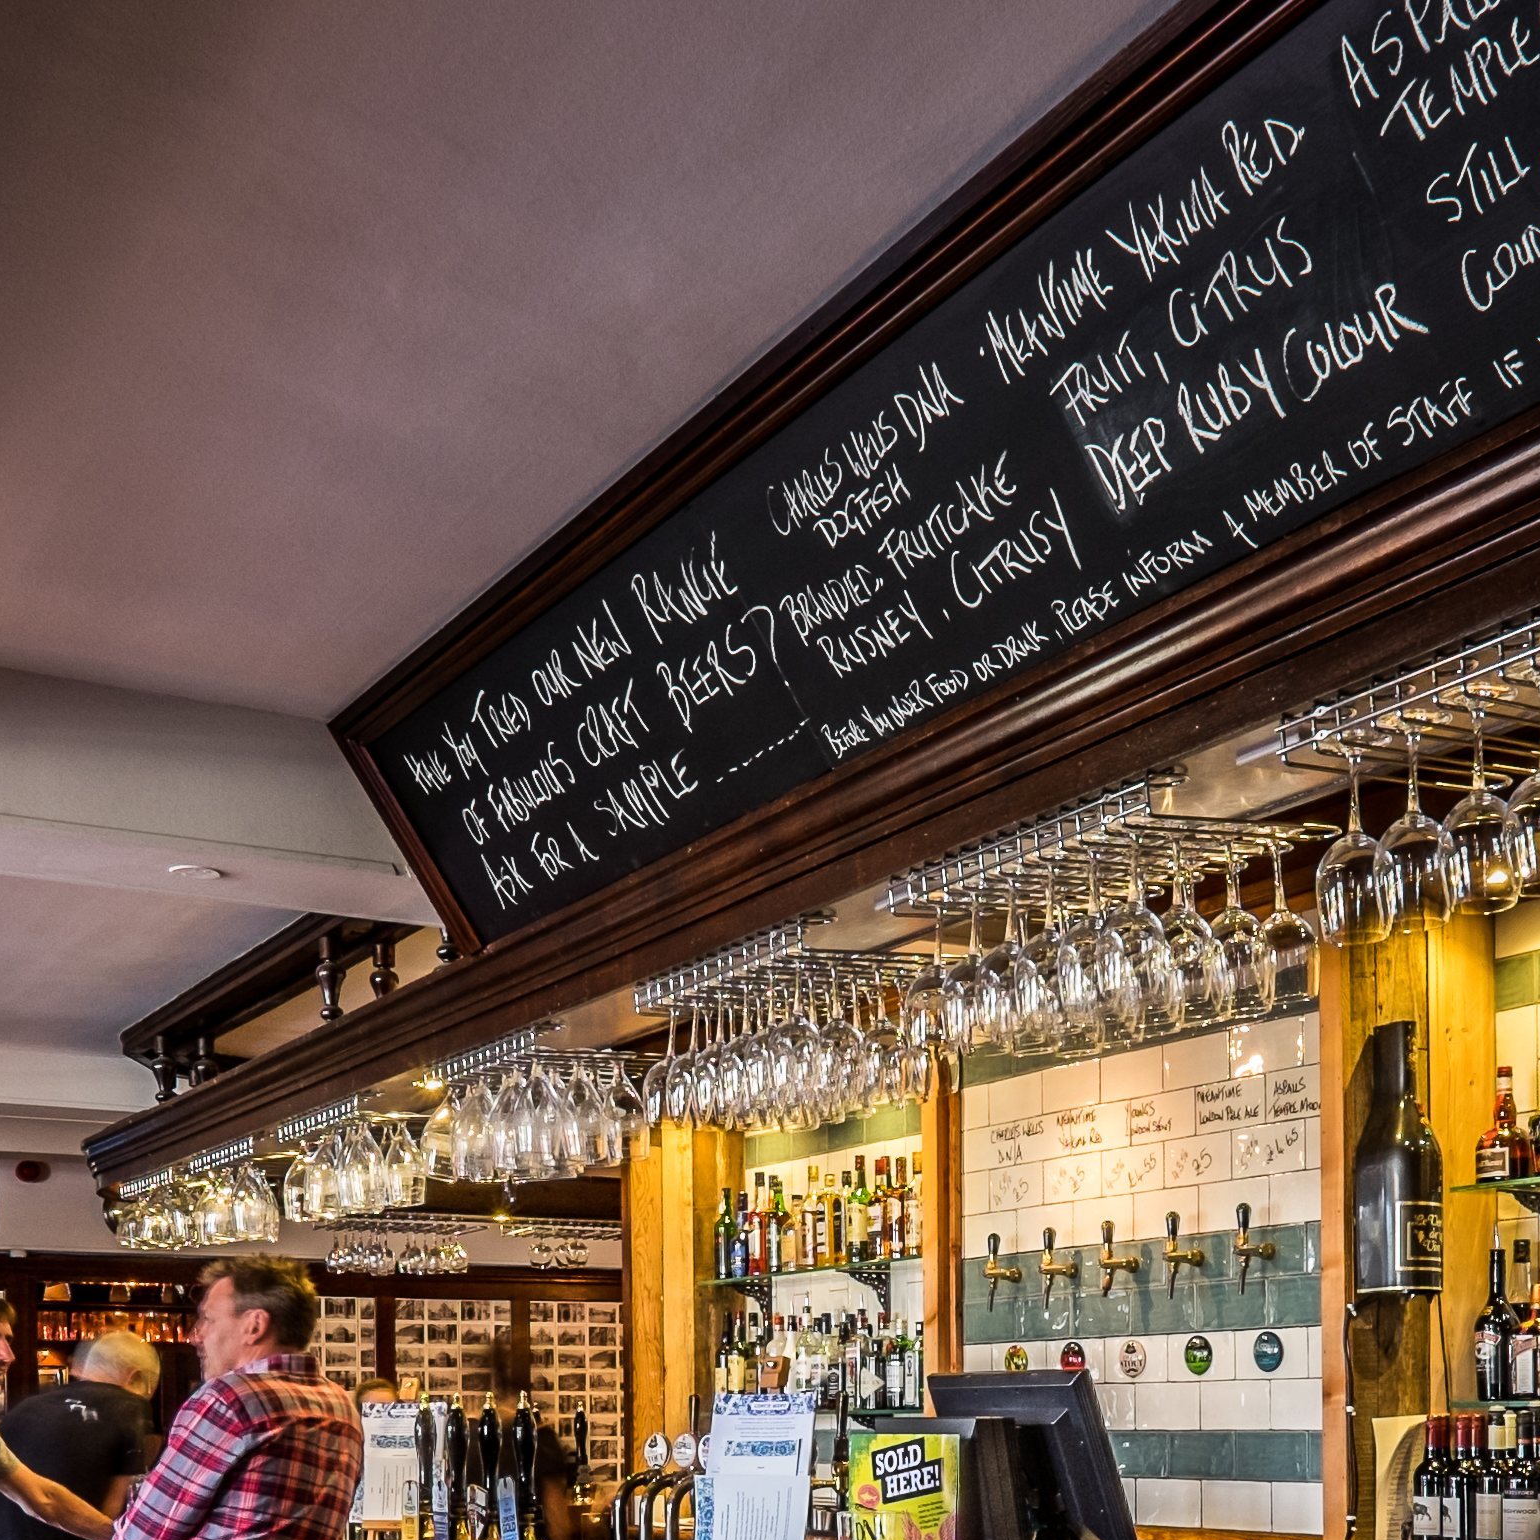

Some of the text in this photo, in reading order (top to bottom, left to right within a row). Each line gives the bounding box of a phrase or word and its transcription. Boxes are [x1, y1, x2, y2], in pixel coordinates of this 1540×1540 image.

[1381, 16, 1540, 141] TEMPLE
[1105, 193, 1231, 282] YAKIMA
[767, 361, 965, 536] CHARLES WELLS DNA
[1085, 283, 1429, 513] DEEP RUBY COLOUR
[813, 462, 911, 549] DOGFISH
[821, 718, 870, 759] BEFORE
[862, 705, 890, 737] YOU
[891, 680, 934, 728] ORDER
[925, 669, 969, 705] FOOD
[973, 653, 1002, 682] OR
[1223, 510, 1259, 549] A
[1243, 450, 1348, 522] MEMBER
[1347, 422, 1382, 470] OF
[1387, 377, 1474, 447] STAFF
[1493, 349, 1524, 388] IF
[878, 449, 1017, 580] FRUITCAKE
[951, 488, 1082, 608] CITRUSY
[403, 530, 738, 795] HAVE YOU TRIED OUR NEW RANGE
[462, 798, 490, 846] OF
[488, 741, 576, 832] FABULOUS
[577, 678, 650, 768] CRAFT
[481, 748, 699, 910] ASK FOR A SAMPLE
[1196, 1083, 1243, 1104] MEANTIME
[1199, 1107, 1225, 1126] LONDON
[1244, 1104, 1260, 1120] ALE
[875, 1443, 923, 1477] SOLD
[885, 1464, 940, 1499] HERE!
